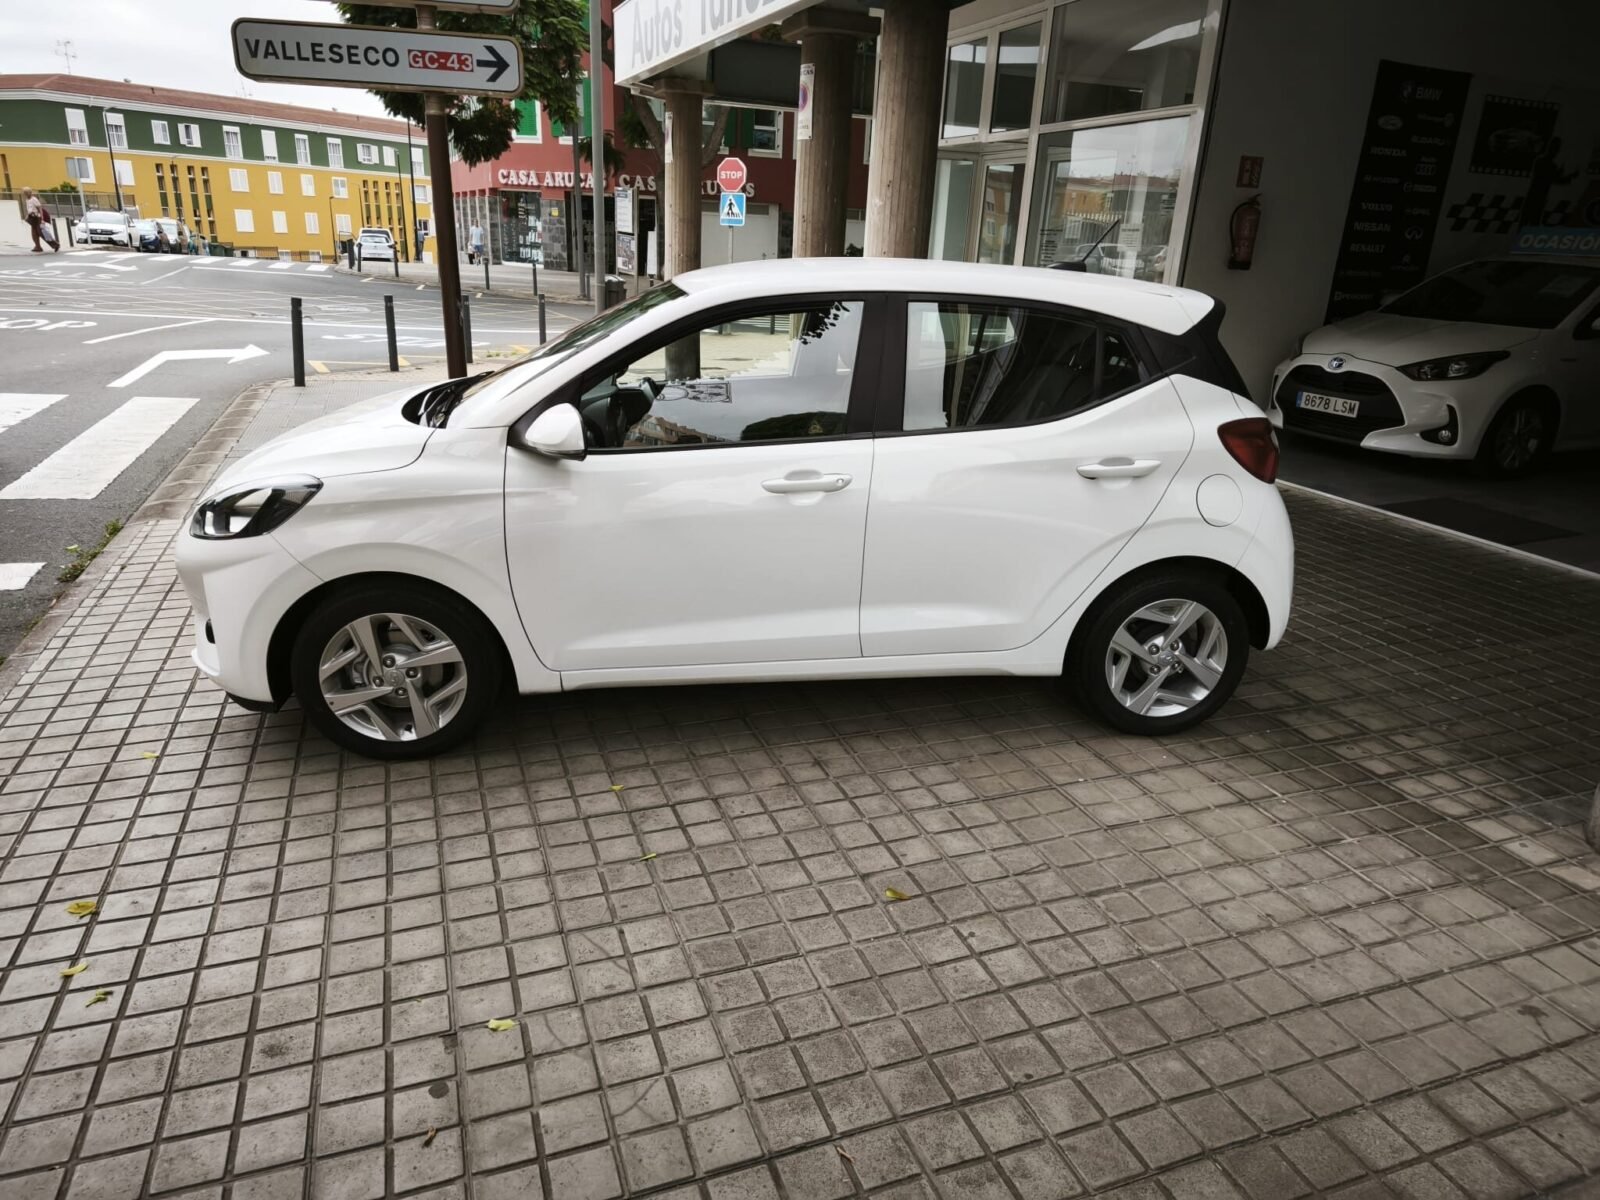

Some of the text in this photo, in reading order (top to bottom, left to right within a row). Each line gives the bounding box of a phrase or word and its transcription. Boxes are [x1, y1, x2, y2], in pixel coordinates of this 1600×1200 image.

[632, 0, 683, 69] Autos
[244, 38, 474, 72] VALLESECO GC-43
[1415, 86, 1443, 101] BMW
[498, 169, 606, 189] CASA ARUA
[618, 174, 657, 192] CAS
[720, 171, 743, 180] STOP
[1354, 222, 1392, 233] NISSAN
[0, 317, 98, 331] OP
[1304, 394, 1357, 415] 8678 LSM
